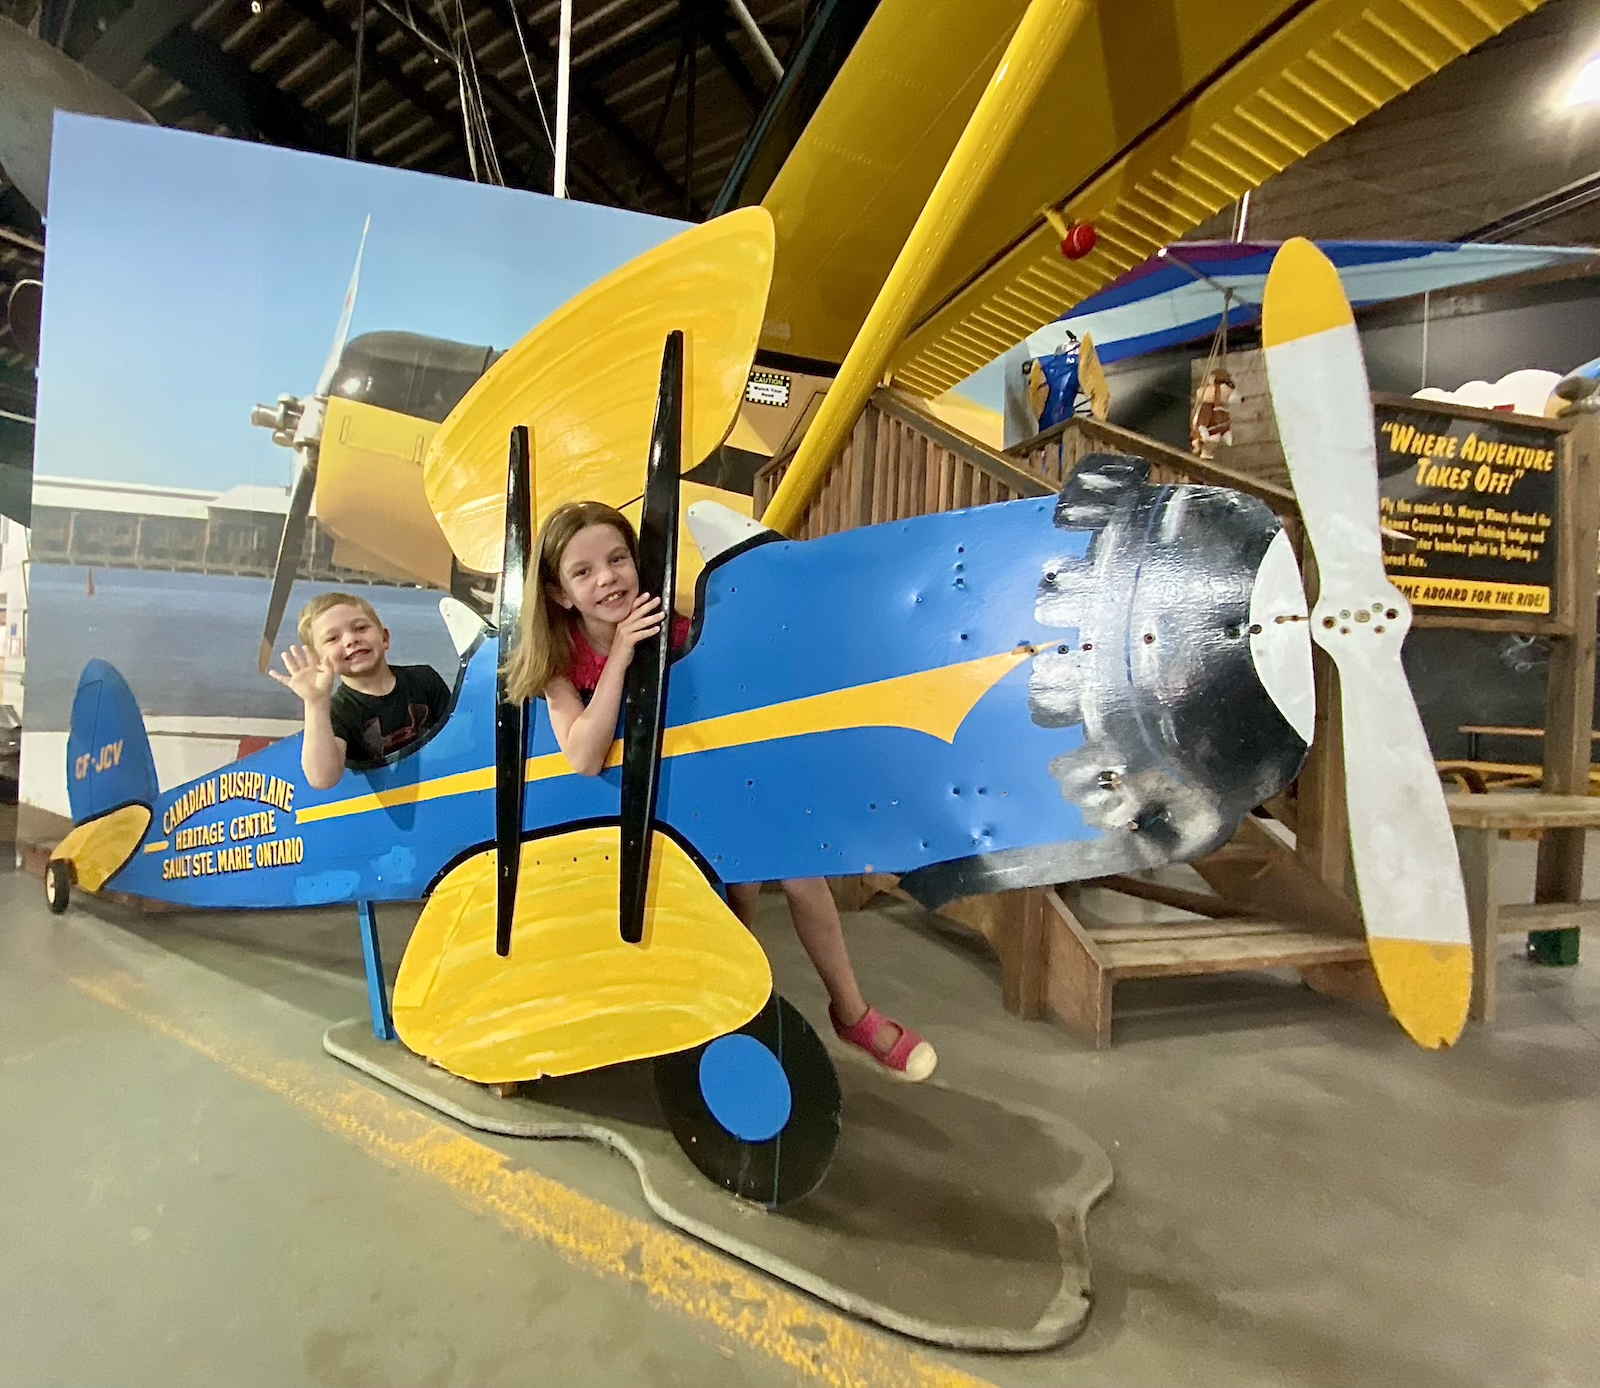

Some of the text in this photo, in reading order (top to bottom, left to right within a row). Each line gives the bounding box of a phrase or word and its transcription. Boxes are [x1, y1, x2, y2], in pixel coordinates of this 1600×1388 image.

[754, 377, 783, 386] CAUTION
[1460, 432, 1554, 471] ADVENTURE
[1416, 457, 1472, 490] TAKES
[1390, 581, 1545, 608] ME ABOARD FOR THE RIDE!
[163, 771, 295, 835] CANADIAN BUSHPLANE
[175, 809, 277, 851] HERITAGE CENTRE
[163, 854, 192, 880] SAULT
[217, 844, 255, 873] MARIE
[255, 835, 304, 868] ONTARIO
